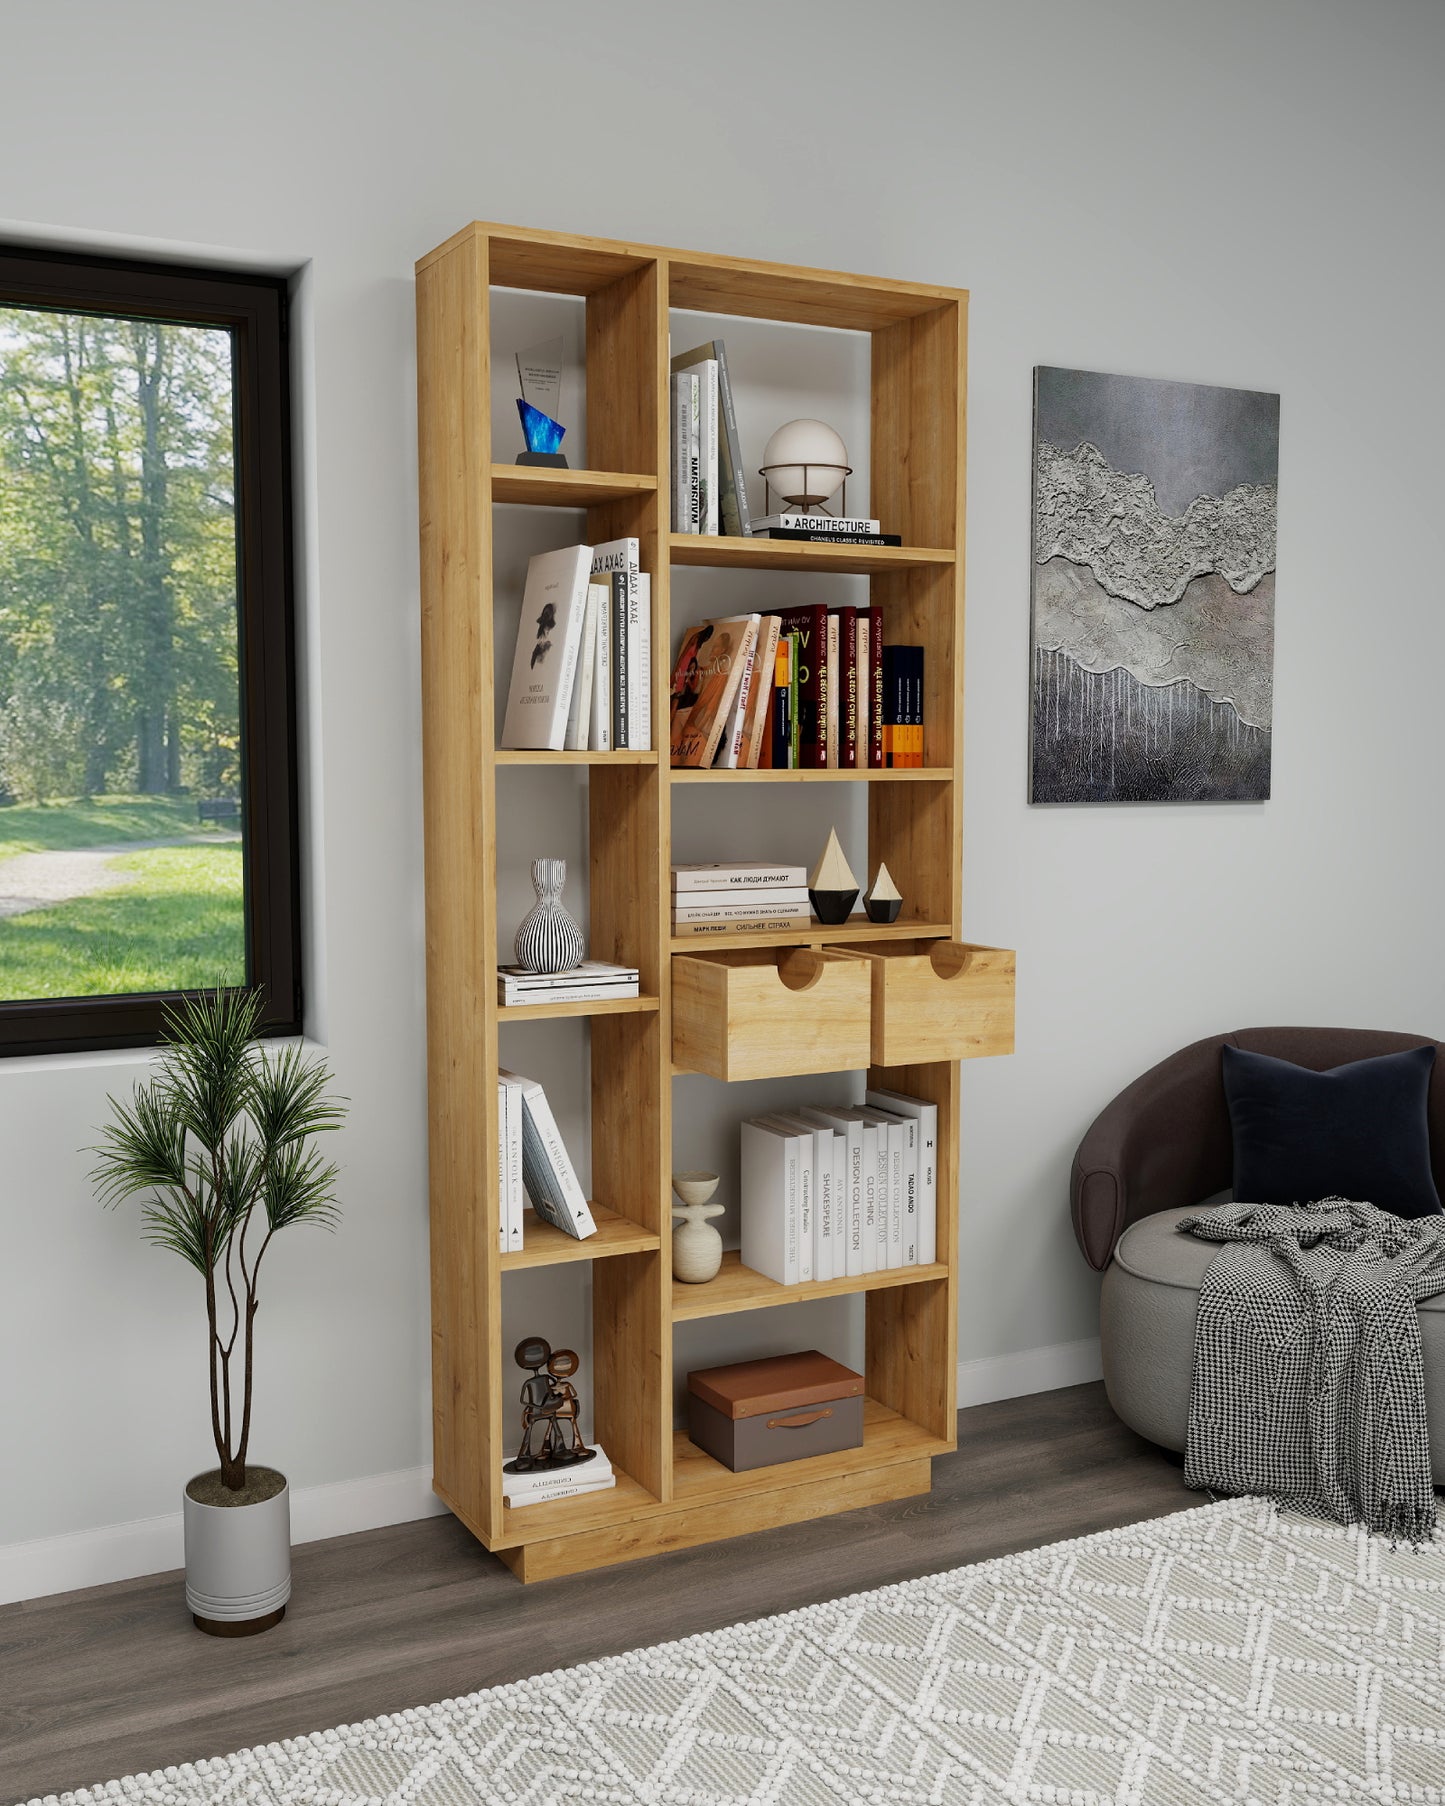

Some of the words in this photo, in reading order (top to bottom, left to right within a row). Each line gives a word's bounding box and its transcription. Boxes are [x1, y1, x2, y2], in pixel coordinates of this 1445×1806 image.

[794, 518, 870, 532] ARCHITECTURE
[550, 1140, 568, 1177] KINFOLK
[878, 1151, 887, 1185] DESIGN
[878, 1187, 887, 1243] COLLECTION
